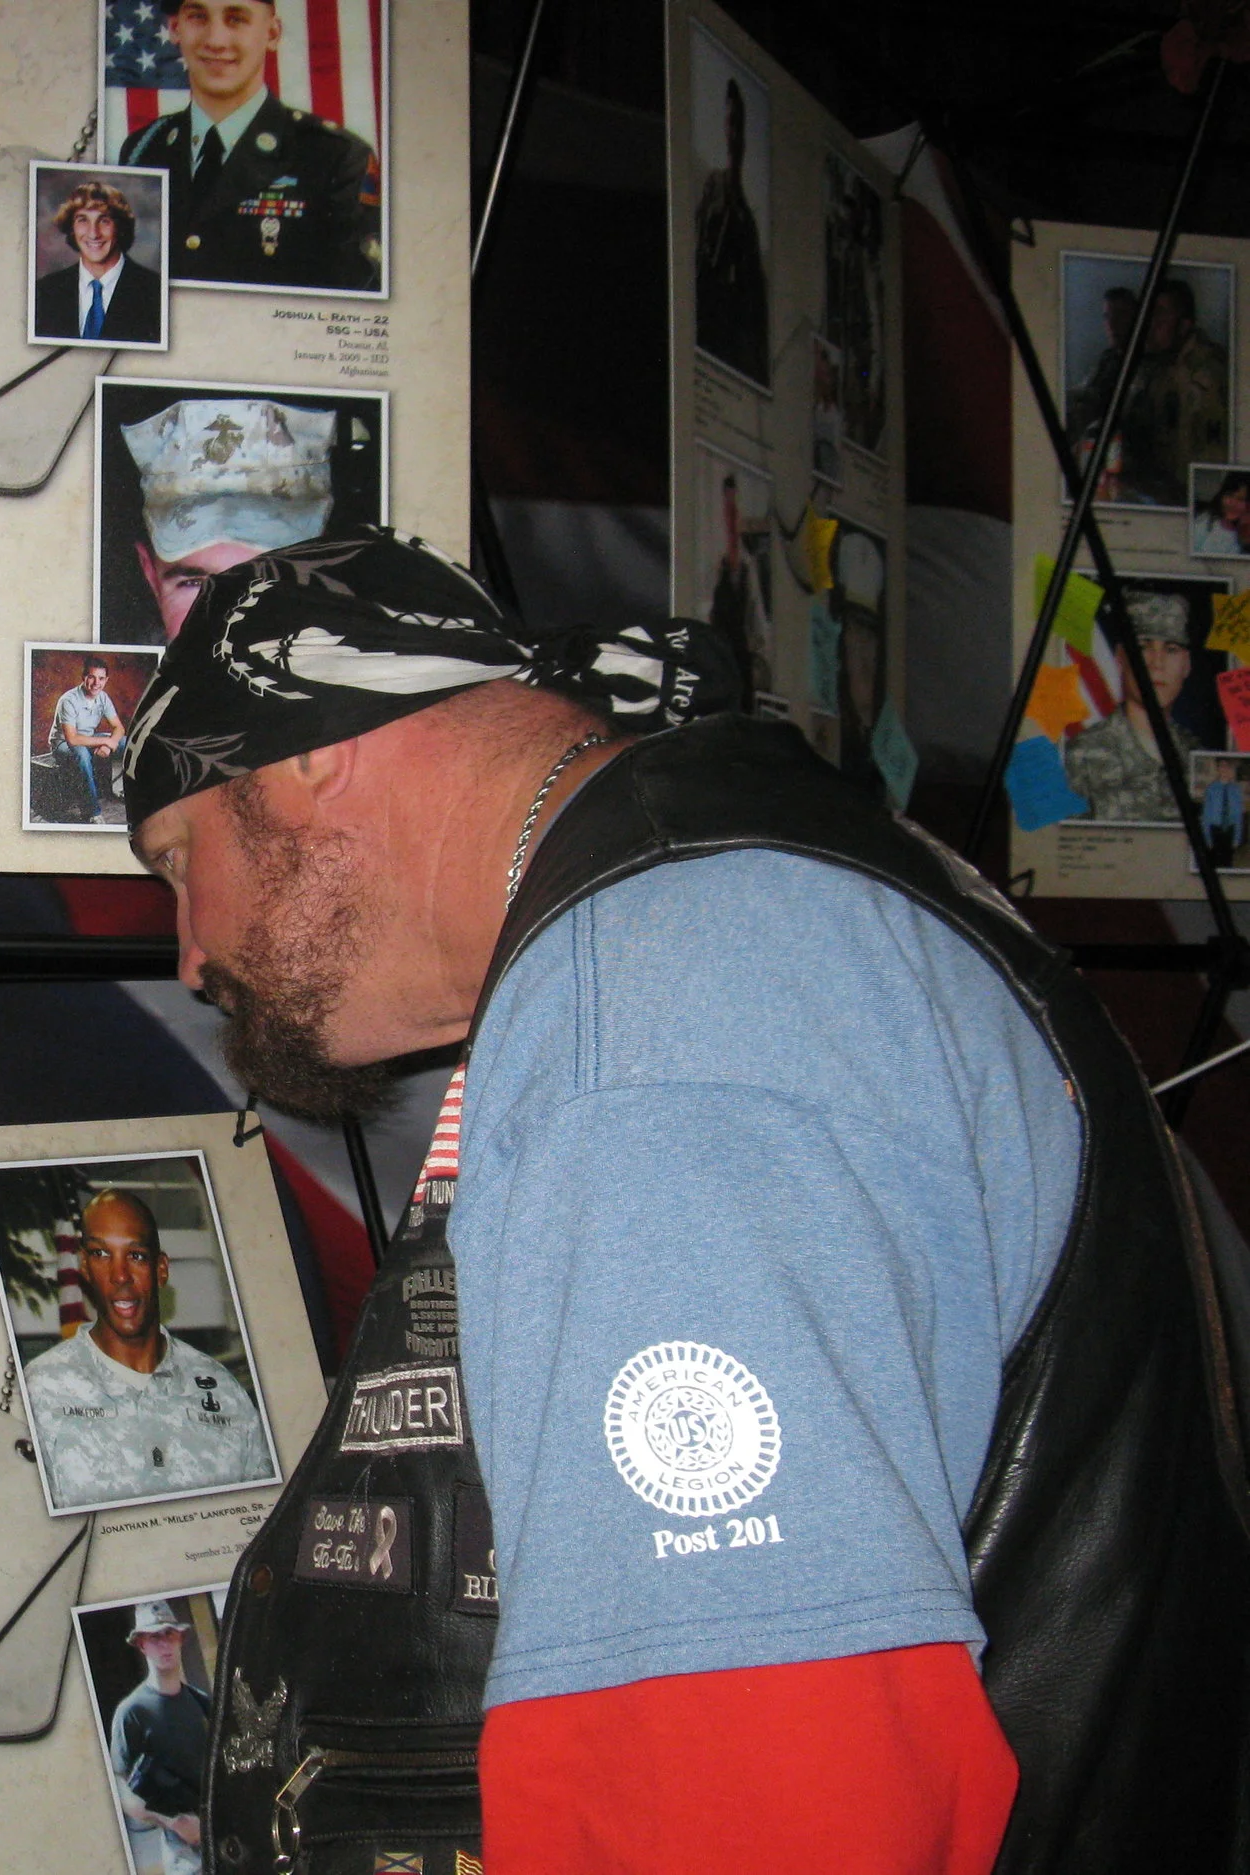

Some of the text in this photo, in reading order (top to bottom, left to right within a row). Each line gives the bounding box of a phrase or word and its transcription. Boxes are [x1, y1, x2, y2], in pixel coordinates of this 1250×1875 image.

[364, 327, 389, 338] USA
[373, 315, 389, 324] 22
[402, 1269, 456, 1303] FALLE
[350, 1386, 450, 1435] THUNDER
[629, 1369, 743, 1423] AMERICAN
[669, 1411, 707, 1446] US
[658, 1460, 744, 1491] LEGION
[100, 1521, 150, 1535] JONATHAN
[240, 1516, 261, 1526] CSM
[652, 1514, 785, 1559] Post 201
